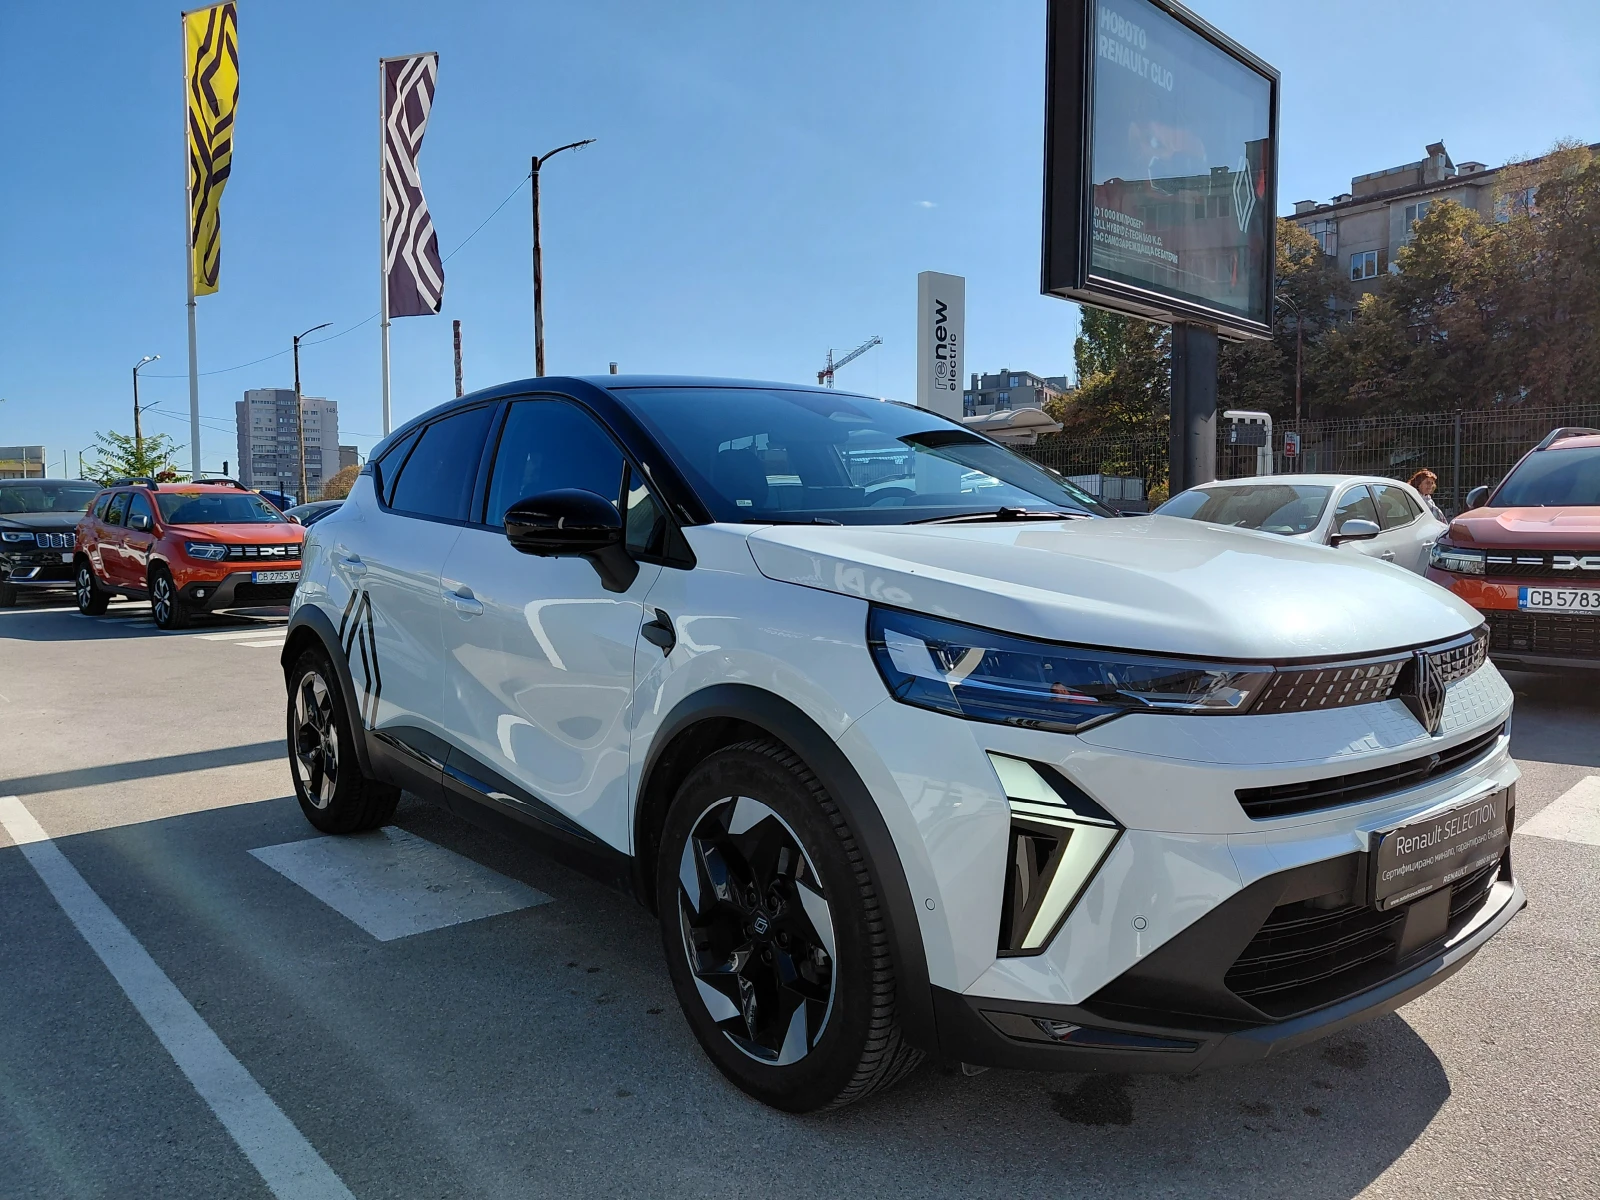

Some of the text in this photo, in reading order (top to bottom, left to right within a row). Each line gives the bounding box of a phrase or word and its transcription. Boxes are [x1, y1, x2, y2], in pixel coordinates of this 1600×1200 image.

[1100, 6, 1147, 50] НОВОТО
[1099, 34, 1173, 92] RENAULT CLIO
[1107, 221, 1124, 236] HYBRID
[935, 299, 948, 390] renew
[948, 333, 957, 391] electric
[258, 571, 300, 581] CB 2755 XB
[1530, 590, 1600, 608] CB 5783
[1396, 802, 1497, 857] Renault SELECTION
[1382, 856, 1434, 881] Сертифицирано
[1434, 847, 1456, 863] минало,
[1456, 836, 1487, 853] гарантирано
[1442, 866, 1468, 883] RENAULT
